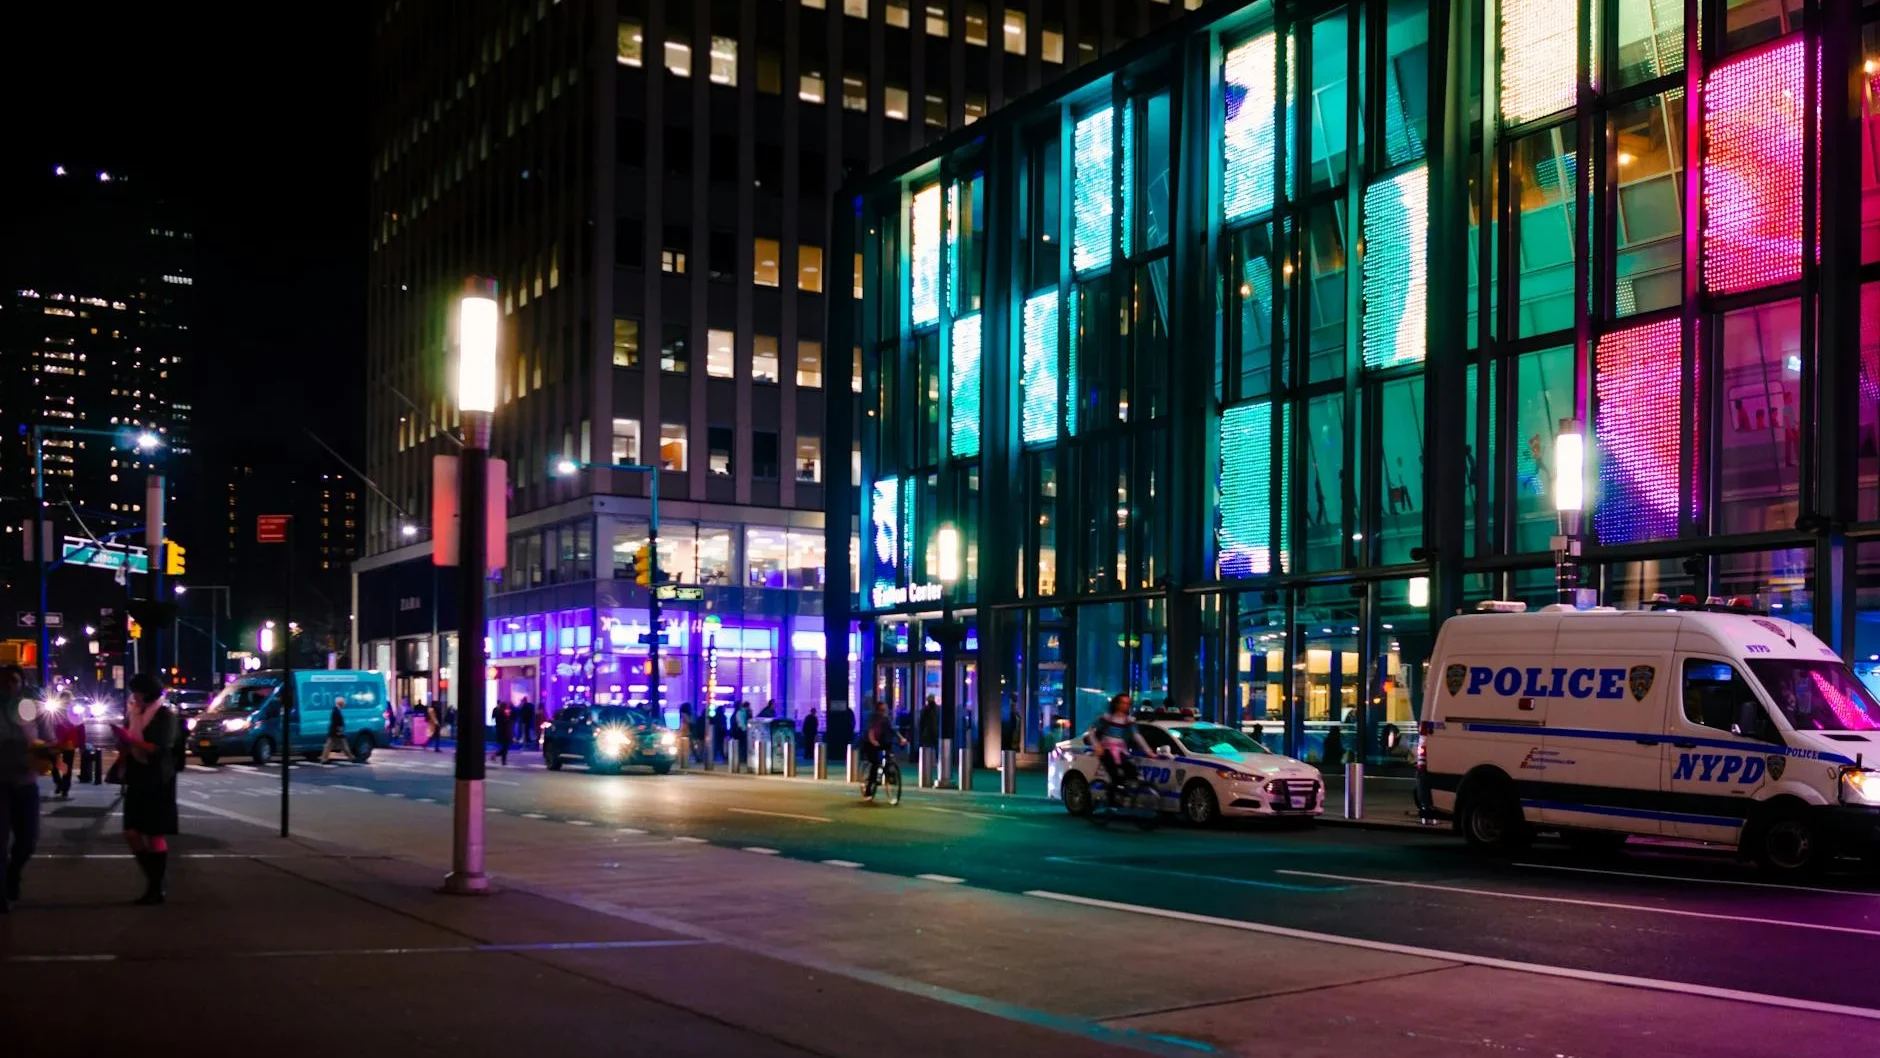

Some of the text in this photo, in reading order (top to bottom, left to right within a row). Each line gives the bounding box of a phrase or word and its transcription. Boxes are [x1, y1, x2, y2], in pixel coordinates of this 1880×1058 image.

[1746, 645, 1770, 653] NYPD
[1467, 667, 1626, 699] POLICE
[1786, 747, 1818, 759] POLICE
[1673, 753, 1766, 784] NYPD
